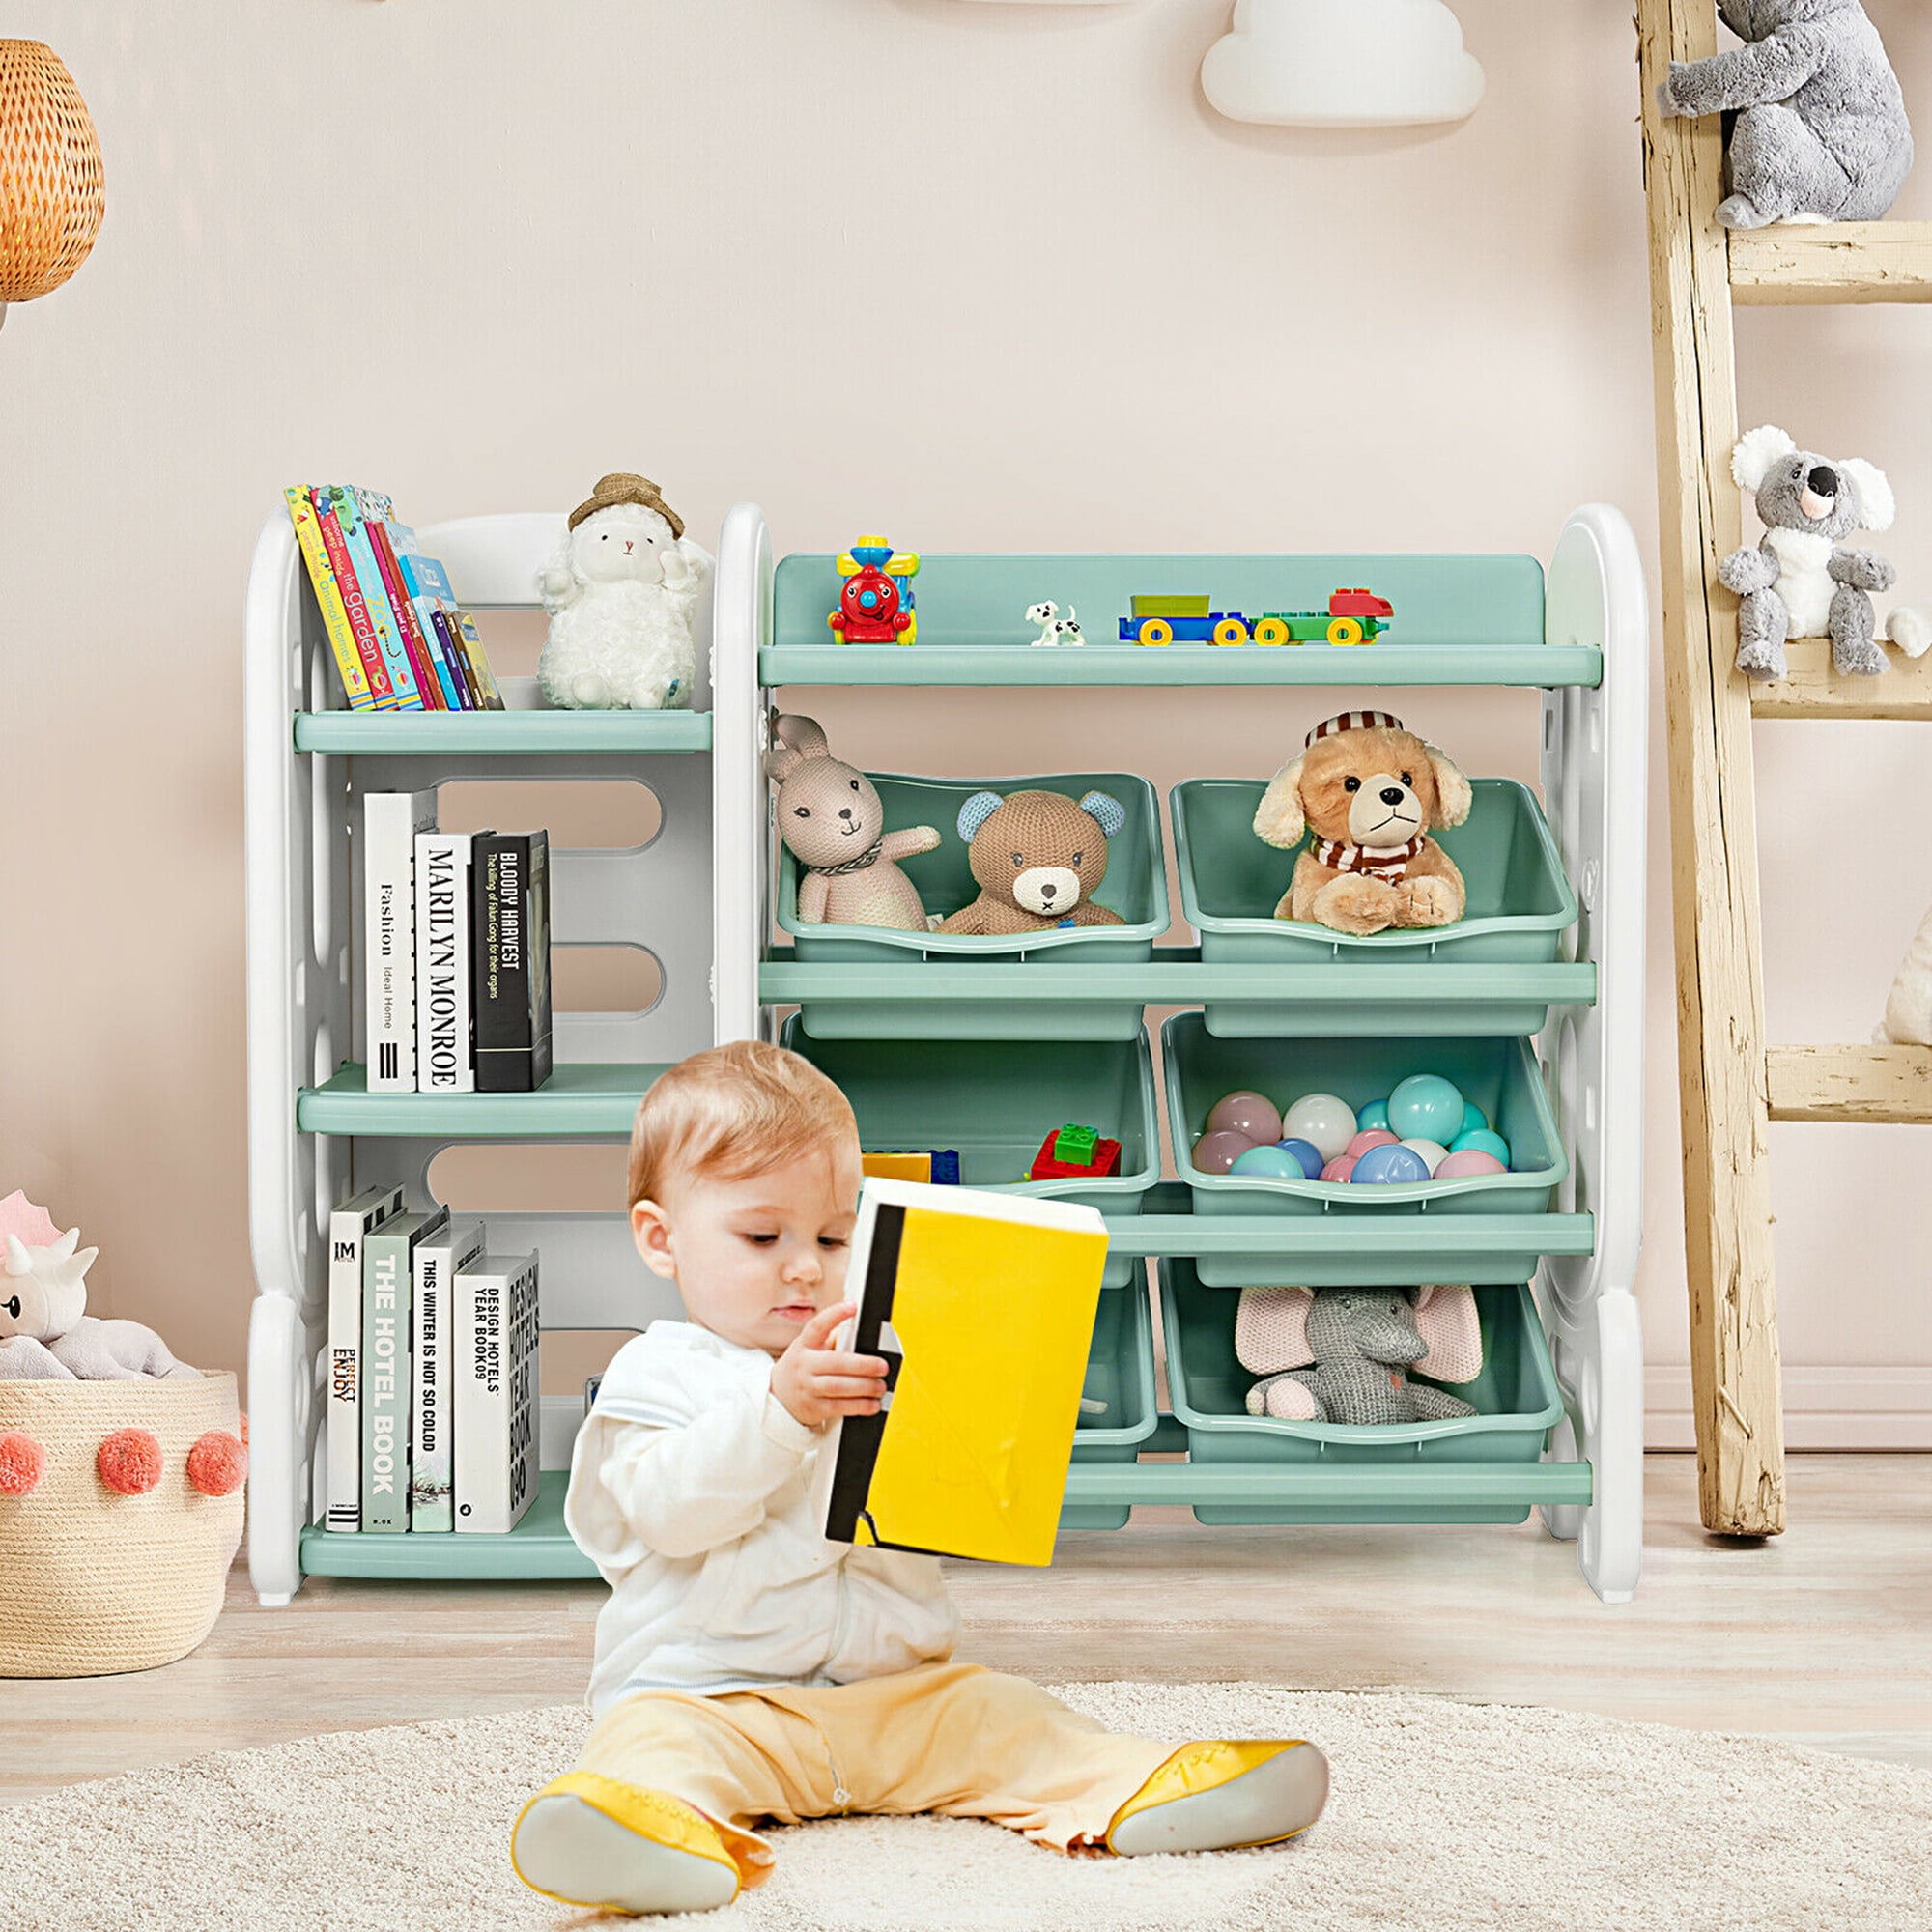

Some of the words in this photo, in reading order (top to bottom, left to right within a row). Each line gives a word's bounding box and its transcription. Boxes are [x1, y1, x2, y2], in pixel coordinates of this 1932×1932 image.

[323, 526, 337, 549] peep
[344, 574, 355, 590] the
[320, 581, 342, 621] animal
[333, 623, 351, 663] homes
[344, 590, 378, 662] garden
[488, 853, 497, 867] The
[485, 868, 497, 890] killing
[500, 853, 518, 905] BLOODY
[429, 849, 454, 967] MARILYN
[488, 893, 498, 901] of
[381, 884, 394, 956] Fashion
[486, 923, 498, 942] Gong
[489, 944, 499, 954] for
[501, 910, 519, 970] HARVEST
[384, 966, 393, 993] Ideal
[489, 955, 498, 973] their
[487, 974, 497, 999] organs
[384, 997, 393, 1029] Home
[430, 975, 457, 1086] MONROE
[375, 1254, 395, 1310] THE
[423, 1260, 436, 1288] THIS
[423, 1292, 436, 1340] WINTER
[475, 1288, 487, 1321] YEAR
[488, 1288, 499, 1336] DESIGN
[374, 1318, 395, 1408] HOTEL
[423, 1345, 436, 1357] IS
[333, 1349, 347, 1402] ENJOY
[346, 1349, 355, 1403] PERFECT
[422, 1361, 435, 1386] NOT
[422, 1389, 435, 1406] SO
[422, 1410, 435, 1452] COLOD
[372, 1415, 394, 1495] BOOK
